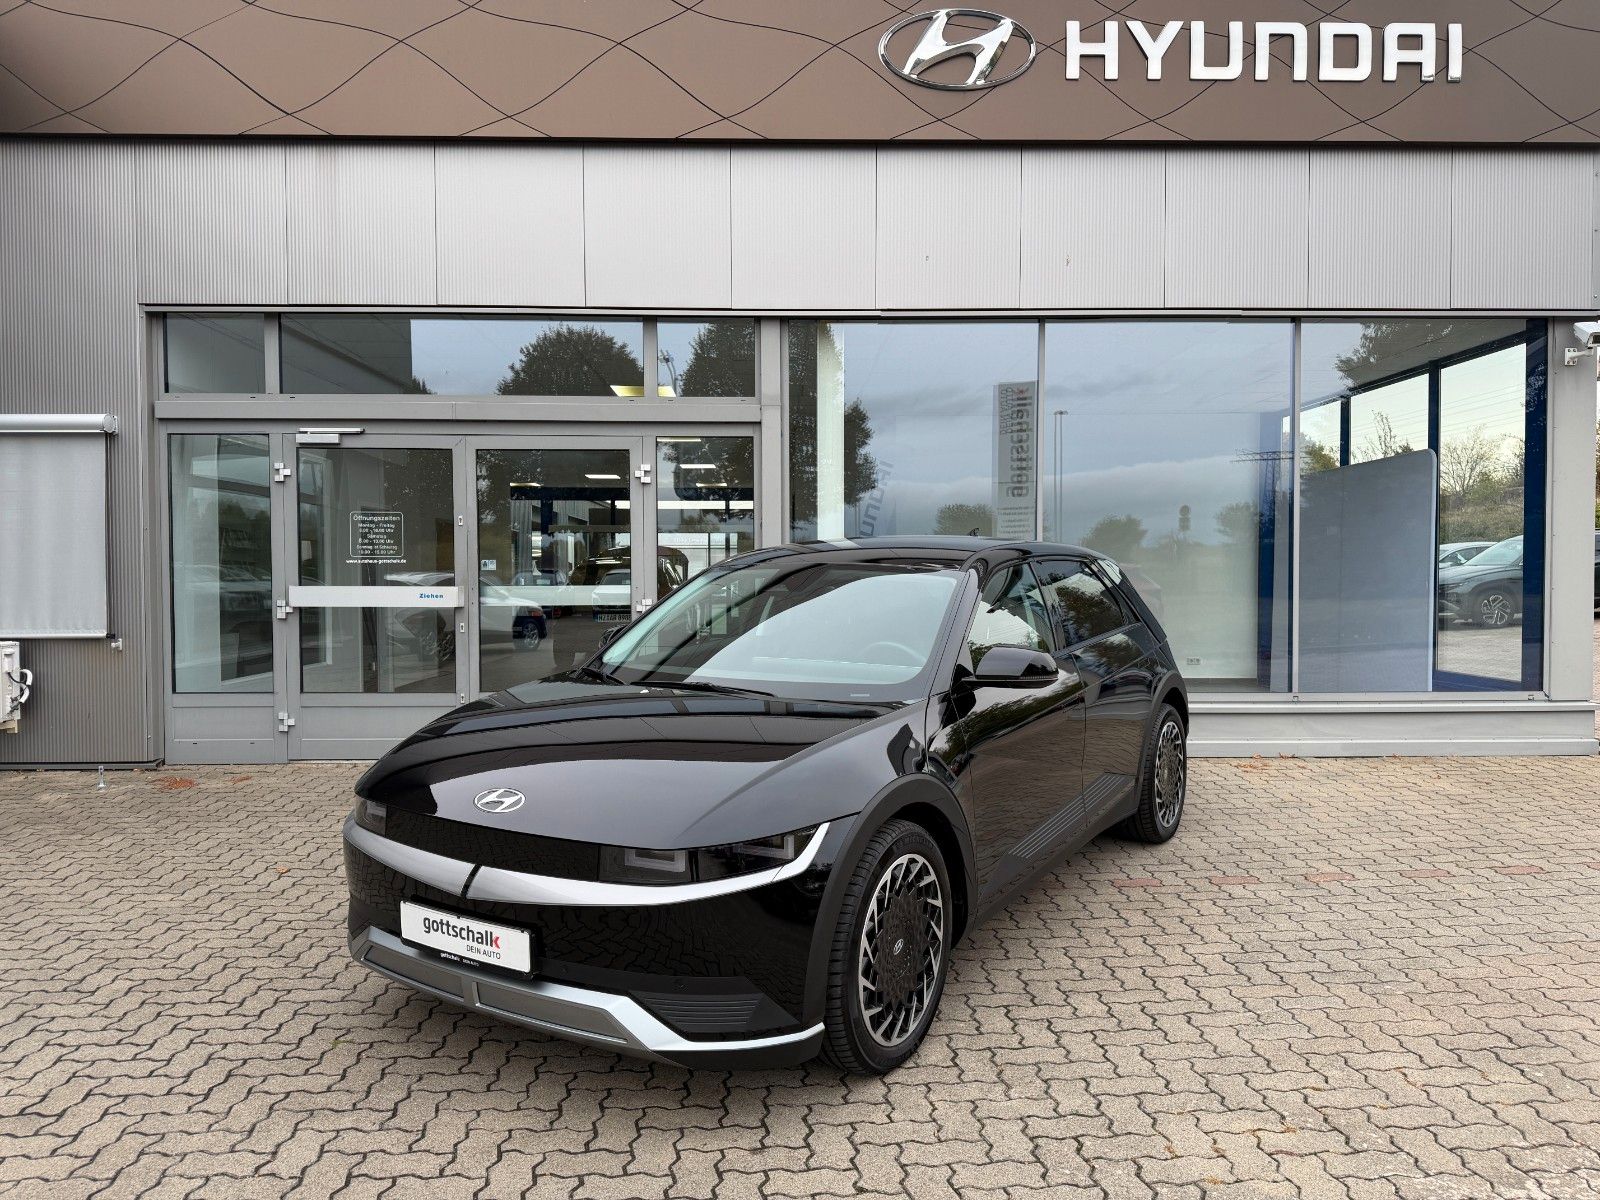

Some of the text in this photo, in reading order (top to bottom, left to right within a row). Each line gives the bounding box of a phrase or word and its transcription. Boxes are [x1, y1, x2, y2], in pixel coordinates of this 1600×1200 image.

[1065, 20, 1463, 83] HYUNDAI
[423, 916, 501, 949] gottschalk
[466, 944, 501, 960] DEIN AUTO
